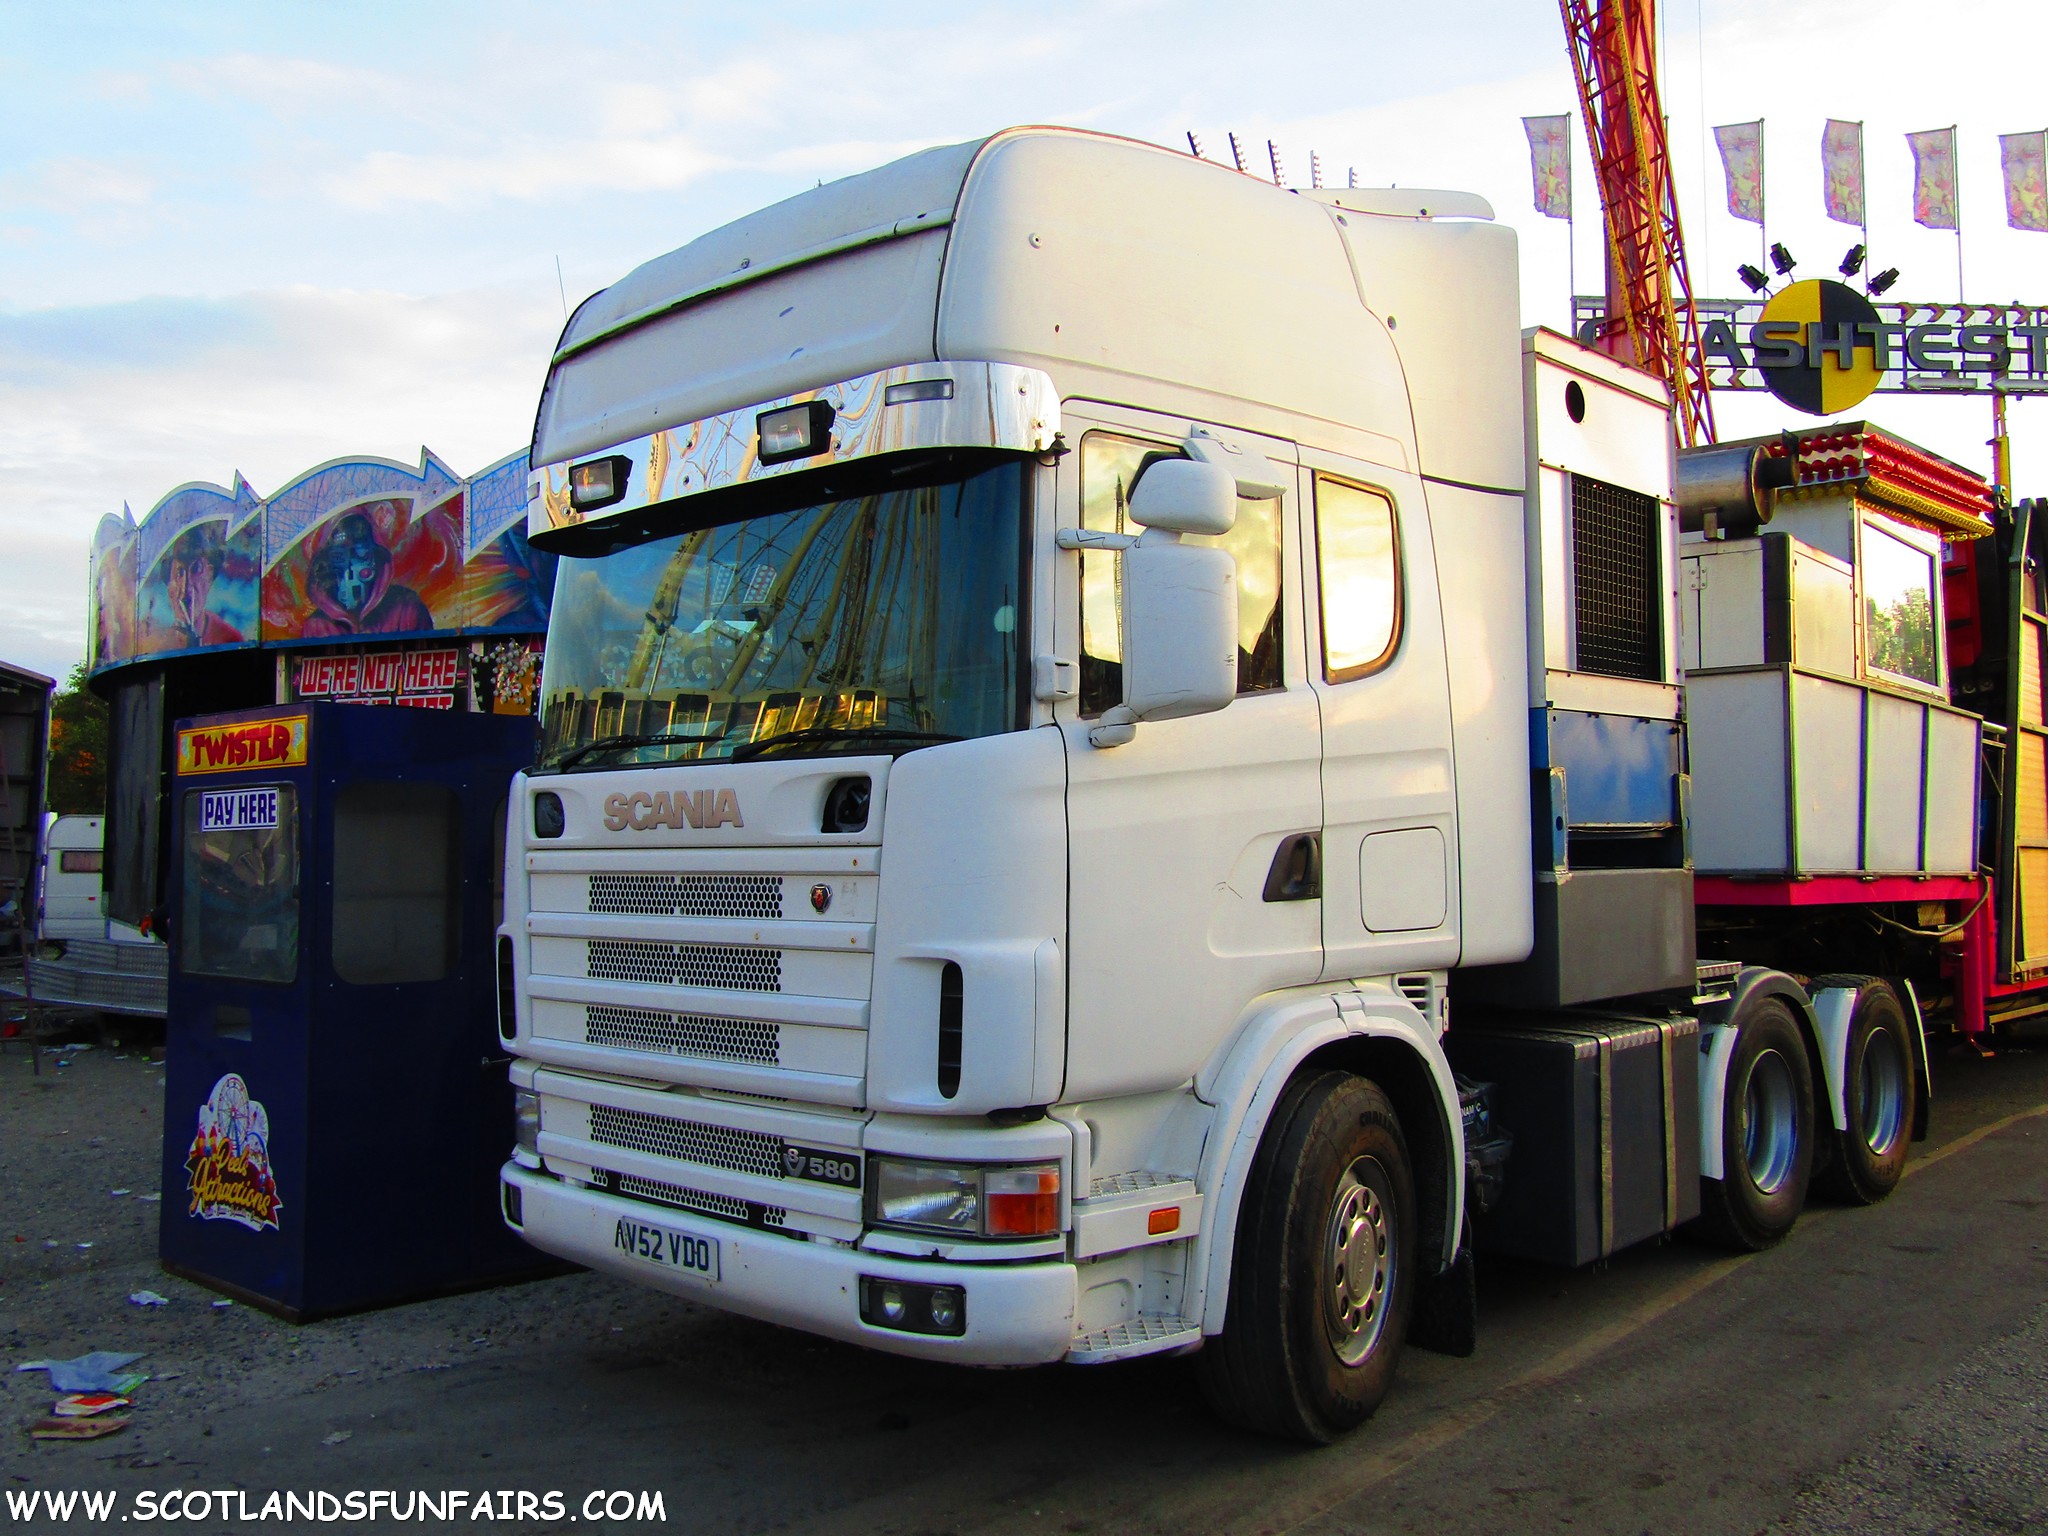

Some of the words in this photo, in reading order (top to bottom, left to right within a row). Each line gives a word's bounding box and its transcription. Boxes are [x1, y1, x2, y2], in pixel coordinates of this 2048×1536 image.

[1579, 317, 2048, 372] ASHTEST
[361, 652, 402, 693] NOT
[403, 649, 459, 691] HERE
[192, 722, 290, 767] TWISTER
[205, 796, 235, 826] PAY
[238, 792, 277, 824] HERE
[603, 788, 744, 831] SCANIA
[190, 1157, 271, 1216] Attractions
[809, 1157, 855, 1182] 580
[615, 1219, 663, 1261] AV52
[669, 1232, 709, 1272] VDO
